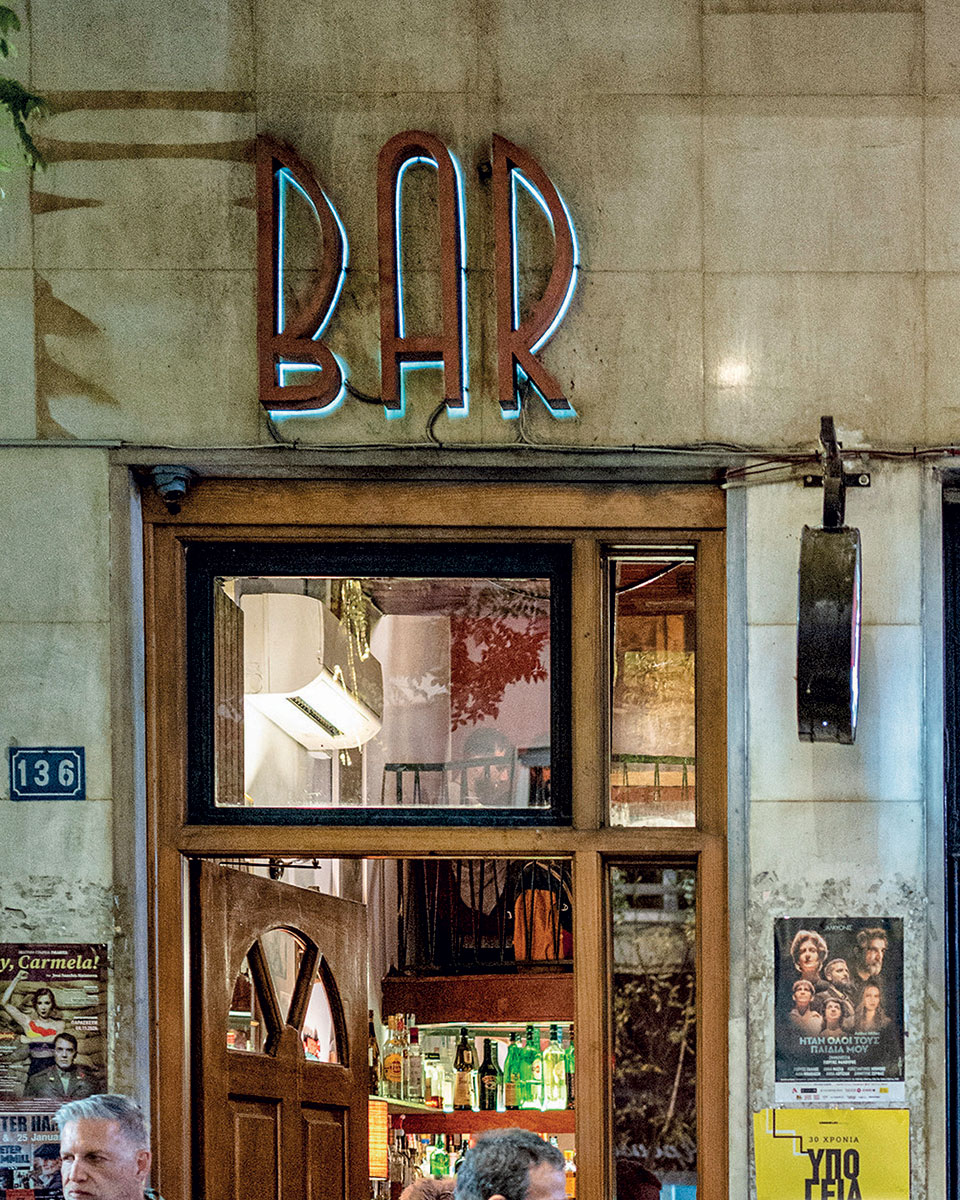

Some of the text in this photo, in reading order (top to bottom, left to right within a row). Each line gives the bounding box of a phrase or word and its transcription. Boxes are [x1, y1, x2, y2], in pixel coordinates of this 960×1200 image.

[256, 130, 579, 419] BAR
[17, 759, 75, 787] 136
[18, 955, 100, 970] Carmela!
[799, 1036, 880, 1045] ΗΤΑΝ ΟΛΟΙ ΤΟΥΣ
[810, 1045, 869, 1053] ΠΑΙΔΙΑ ΜΟΥ
[17, 1133, 28, 1142] 25
[806, 1149, 860, 1180] ΥΠΟ
